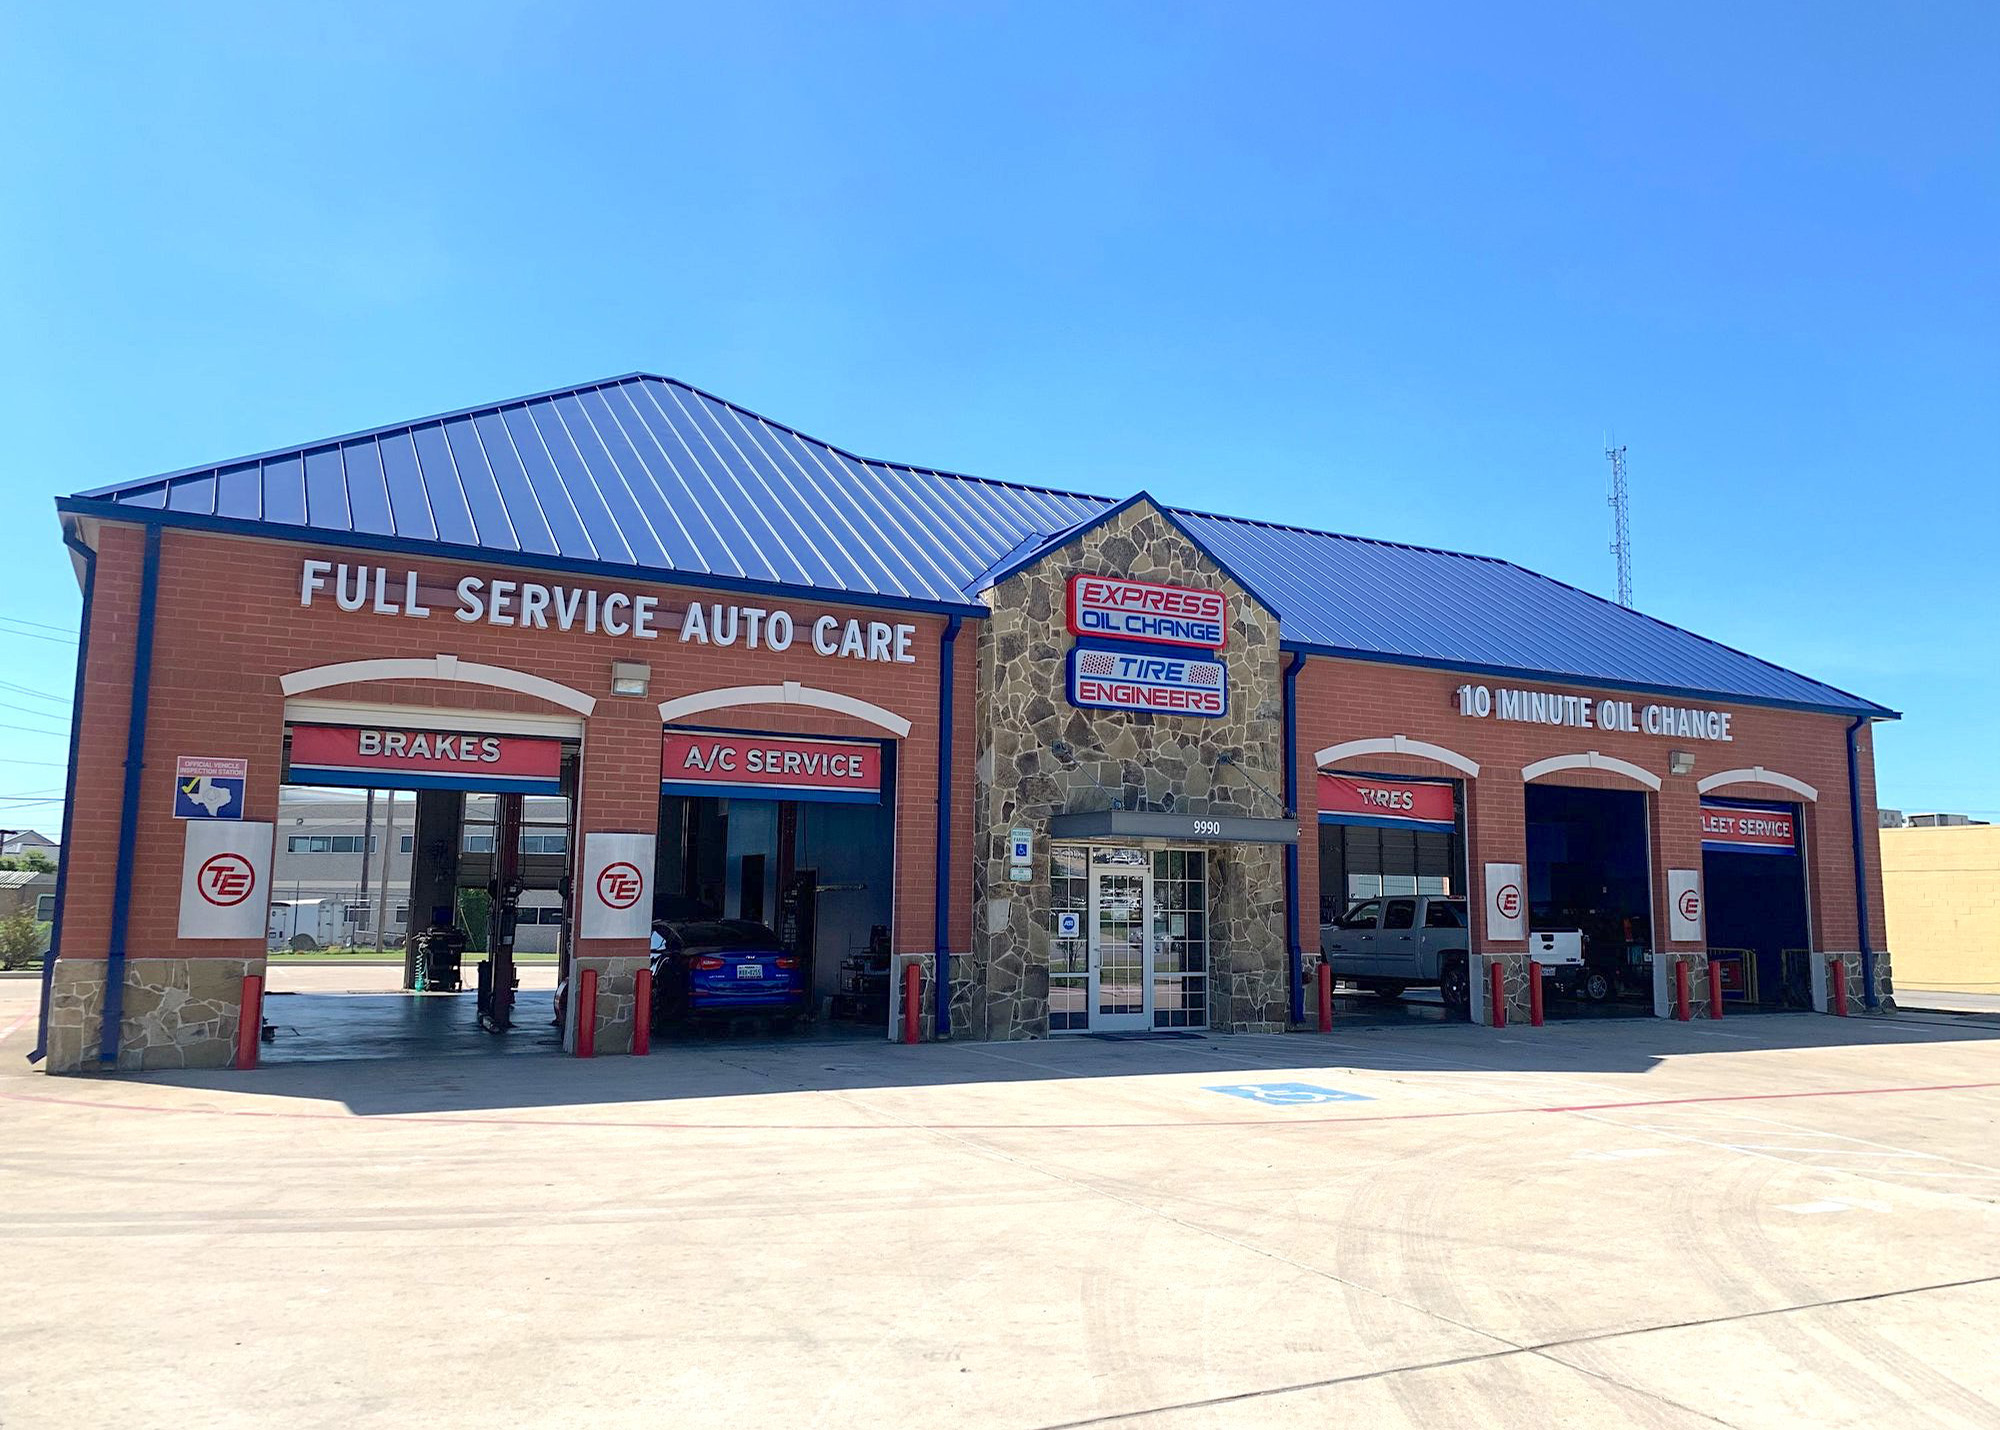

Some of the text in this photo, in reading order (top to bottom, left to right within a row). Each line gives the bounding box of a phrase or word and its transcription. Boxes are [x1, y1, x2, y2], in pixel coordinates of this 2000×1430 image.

[301, 559, 916, 664] FULL SERVICE AUTO CARE
[1082, 582, 1221, 617] EXPRESS
[1082, 610, 1221, 642] OIL CHANGE
[1119, 657, 1185, 682] TIRE
[1079, 681, 1221, 712] ENGINEERS
[1458, 684, 1733, 741] 10 MINUTE OIL CHANGE
[358, 729, 501, 764] BRAKES
[683, 744, 864, 778] A/C SERVICE
[180, 767, 217, 775] INSPECTION
[184, 760, 213, 768] OFFICIAL
[1356, 787, 1414, 811] TIRES
[1193, 820, 1220, 835] 9990
[1739, 818, 1792, 838] SERVICE
[207, 866, 250, 896] TE
[604, 873, 639, 900] TE
